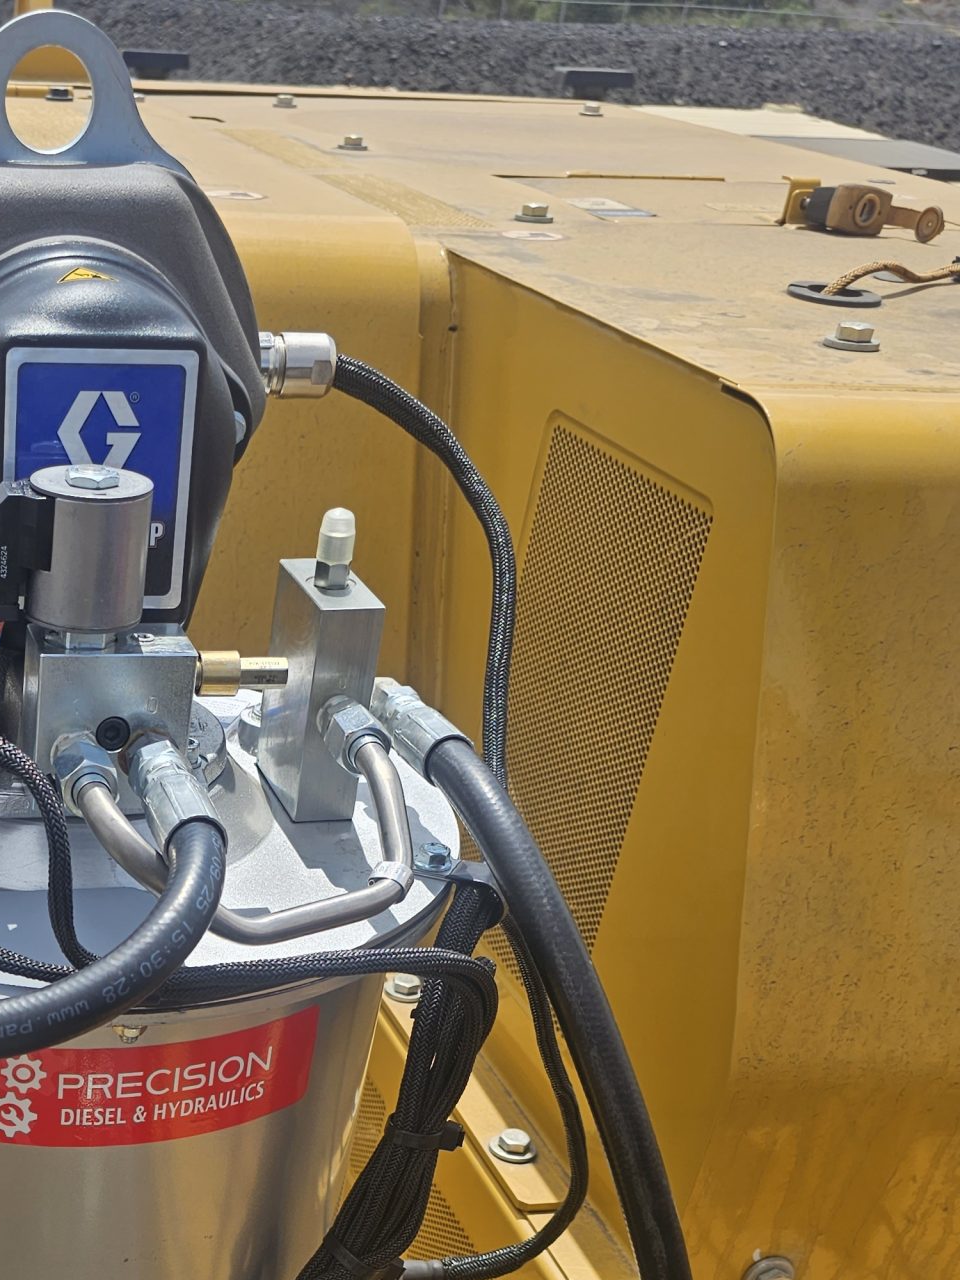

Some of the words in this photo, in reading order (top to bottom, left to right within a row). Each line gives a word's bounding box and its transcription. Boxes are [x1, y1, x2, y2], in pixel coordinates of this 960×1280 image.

[101, 919, 193, 1004] 15:30:28
[56, 1045, 274, 1101] PRECISION
[60, 1106, 127, 1127] DIESEL
[133, 1107, 147, 1124] &
[153, 1080, 266, 1122] HYDRAULICS
